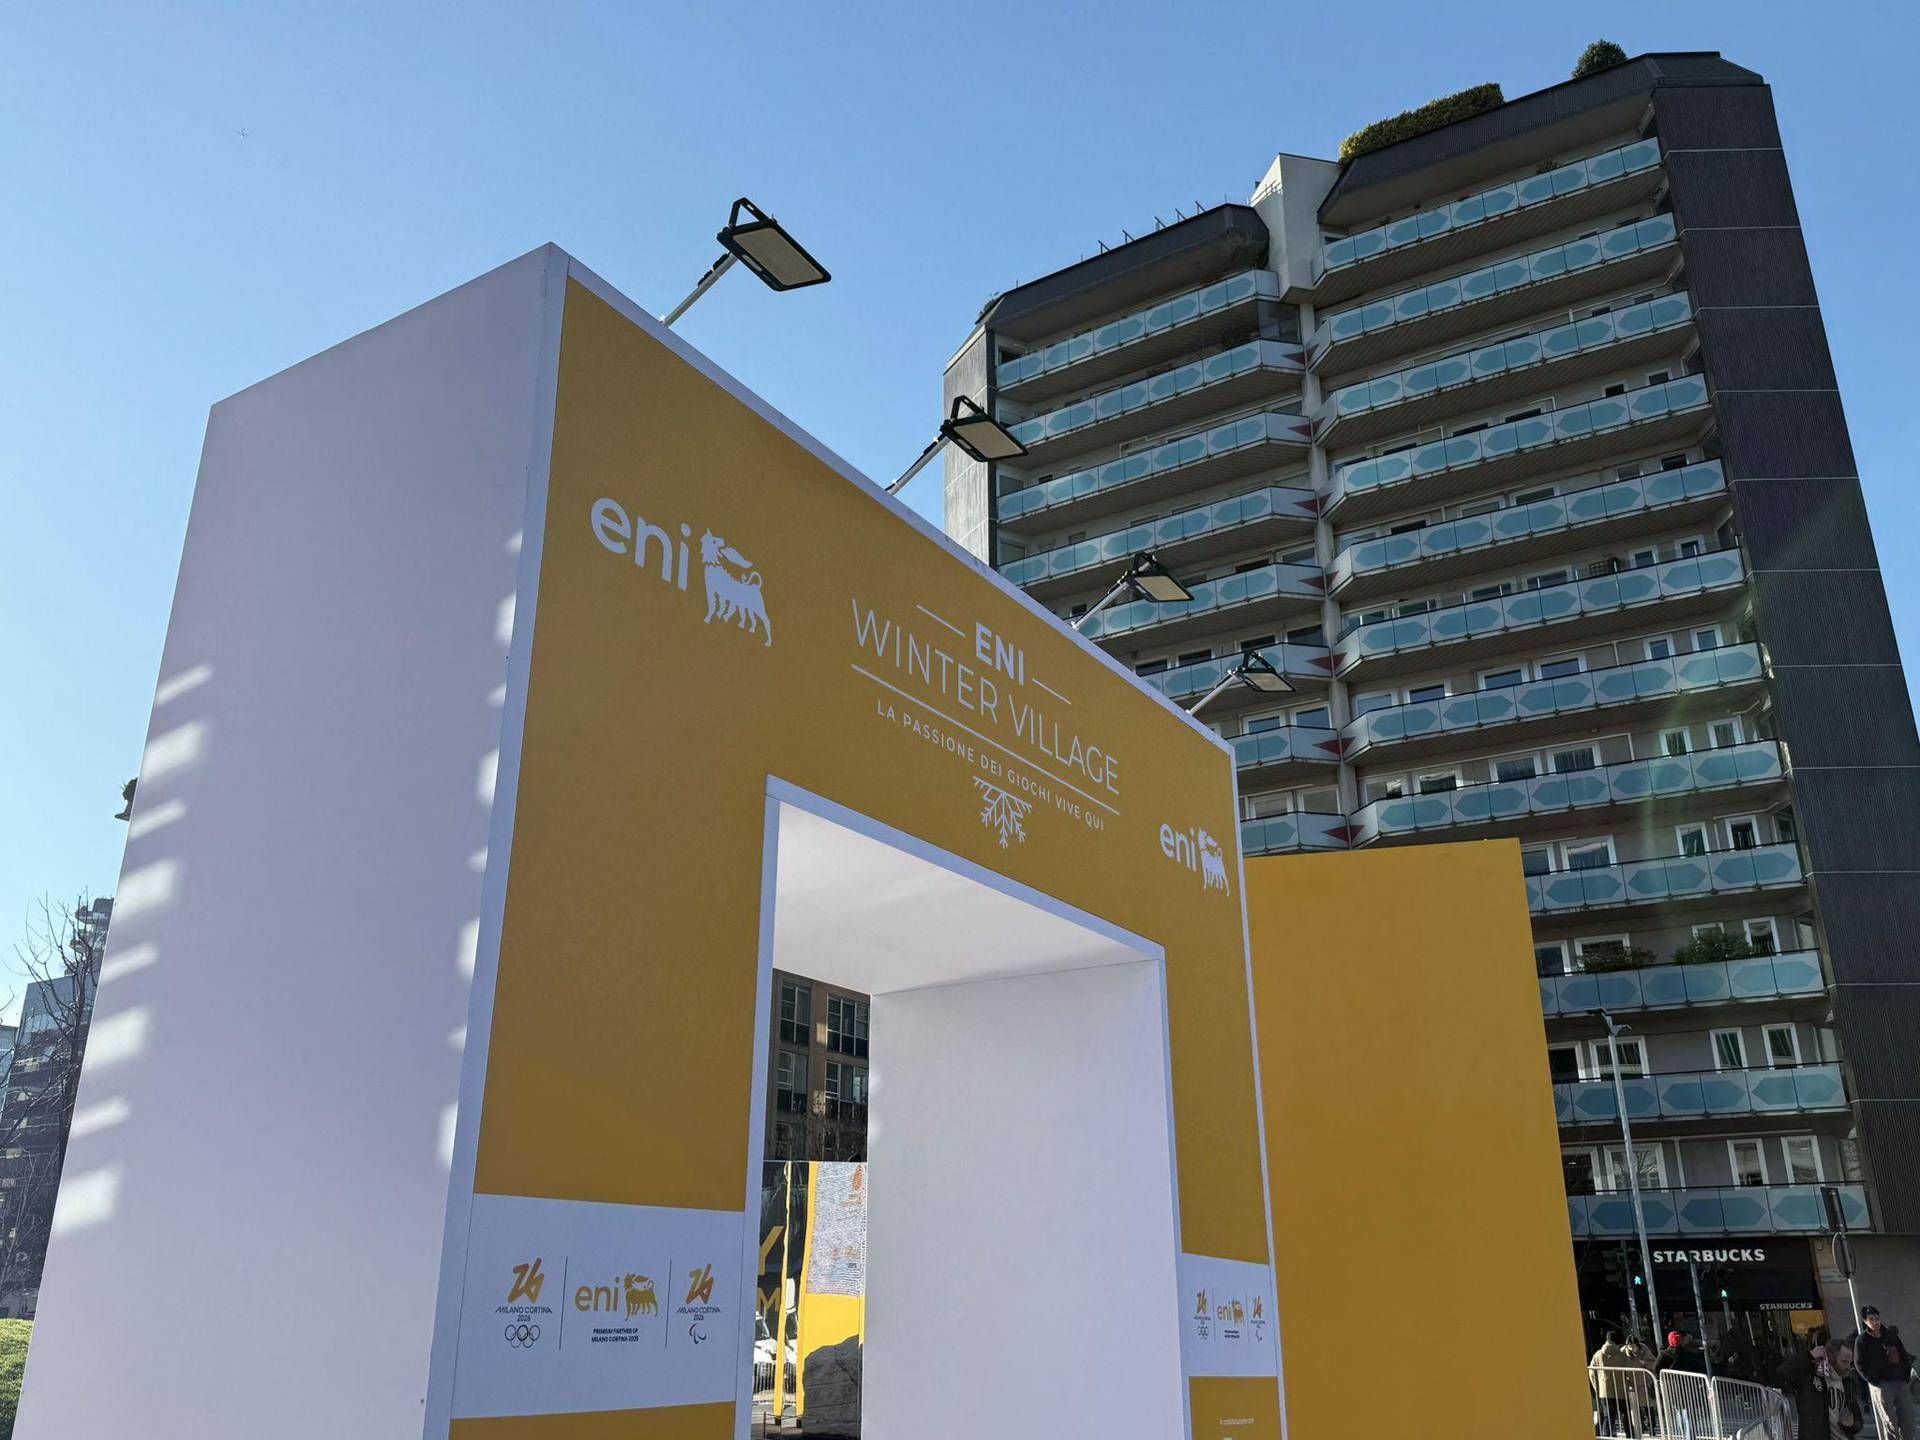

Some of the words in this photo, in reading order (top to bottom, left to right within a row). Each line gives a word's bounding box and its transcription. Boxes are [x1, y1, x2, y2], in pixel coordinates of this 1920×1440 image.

[590, 497, 692, 591] eni
[975, 621, 1025, 687] ENI
[851, 598, 998, 724] WINTER
[1008, 694, 1120, 795] VILLAGE
[877, 699, 897, 722] LA
[903, 717, 975, 763] PASSIONE
[980, 753, 1003, 777] DEI
[1007, 769, 1051, 804] GIOCHI
[1055, 794, 1081, 819] VIVE
[1084, 810, 1105, 832] QUI
[1159, 823, 1197, 872] eni
[1653, 1248, 1766, 1263] STARBUCKS
[495, 1306, 524, 1314] MILANO
[524, 1306, 553, 1314] CORTINA
[575, 1276, 620, 1312] eni
[1216, 1300, 1232, 1321] eni
[1759, 1302, 1813, 1310] STARBUCKS
